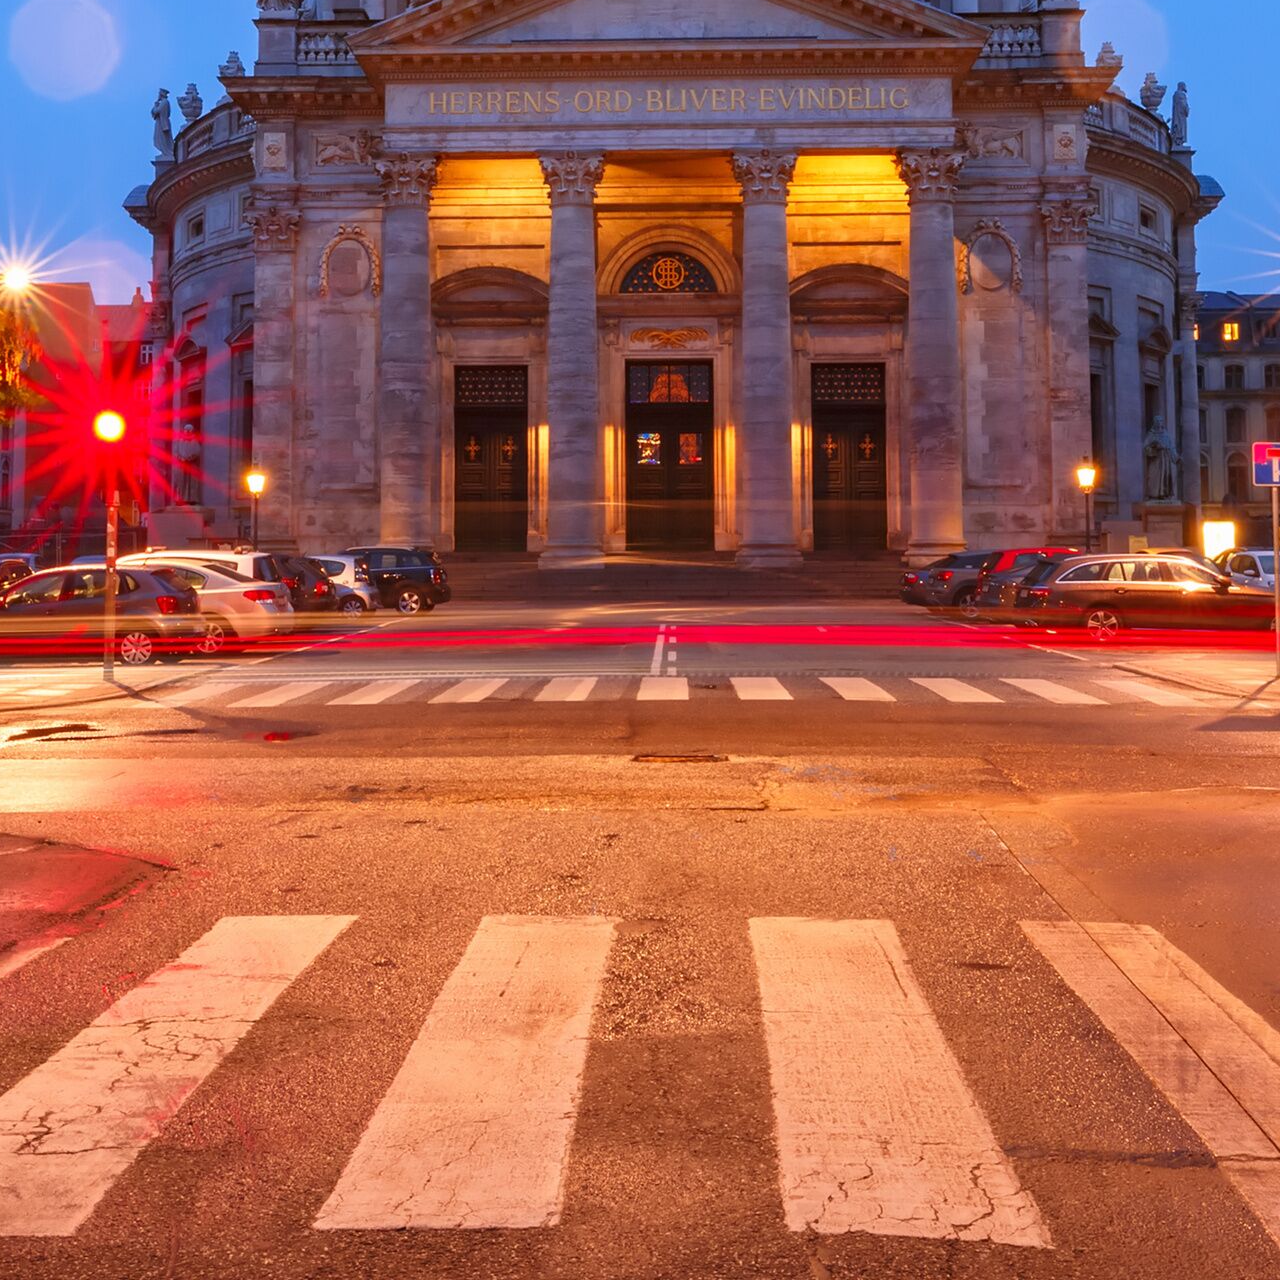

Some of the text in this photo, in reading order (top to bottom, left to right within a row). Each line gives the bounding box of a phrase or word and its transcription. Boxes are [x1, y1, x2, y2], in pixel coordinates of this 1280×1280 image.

[428, 86, 910, 114] HERRENS ORD BLIVER EVINDELIG
